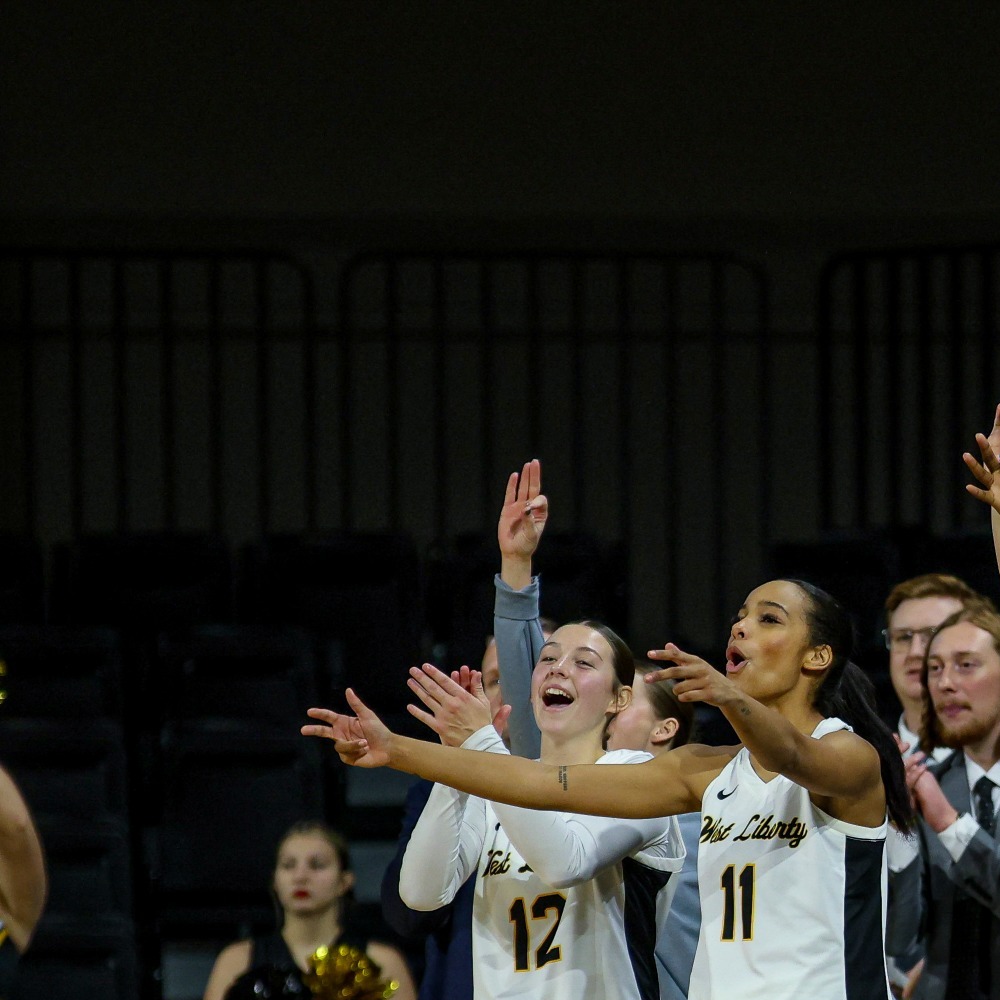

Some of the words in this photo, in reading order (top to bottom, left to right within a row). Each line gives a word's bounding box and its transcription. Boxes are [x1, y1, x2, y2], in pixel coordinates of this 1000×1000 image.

[732, 814, 809, 849] Liberty
[508, 891, 568, 973] 12
[720, 863, 757, 943] 11
